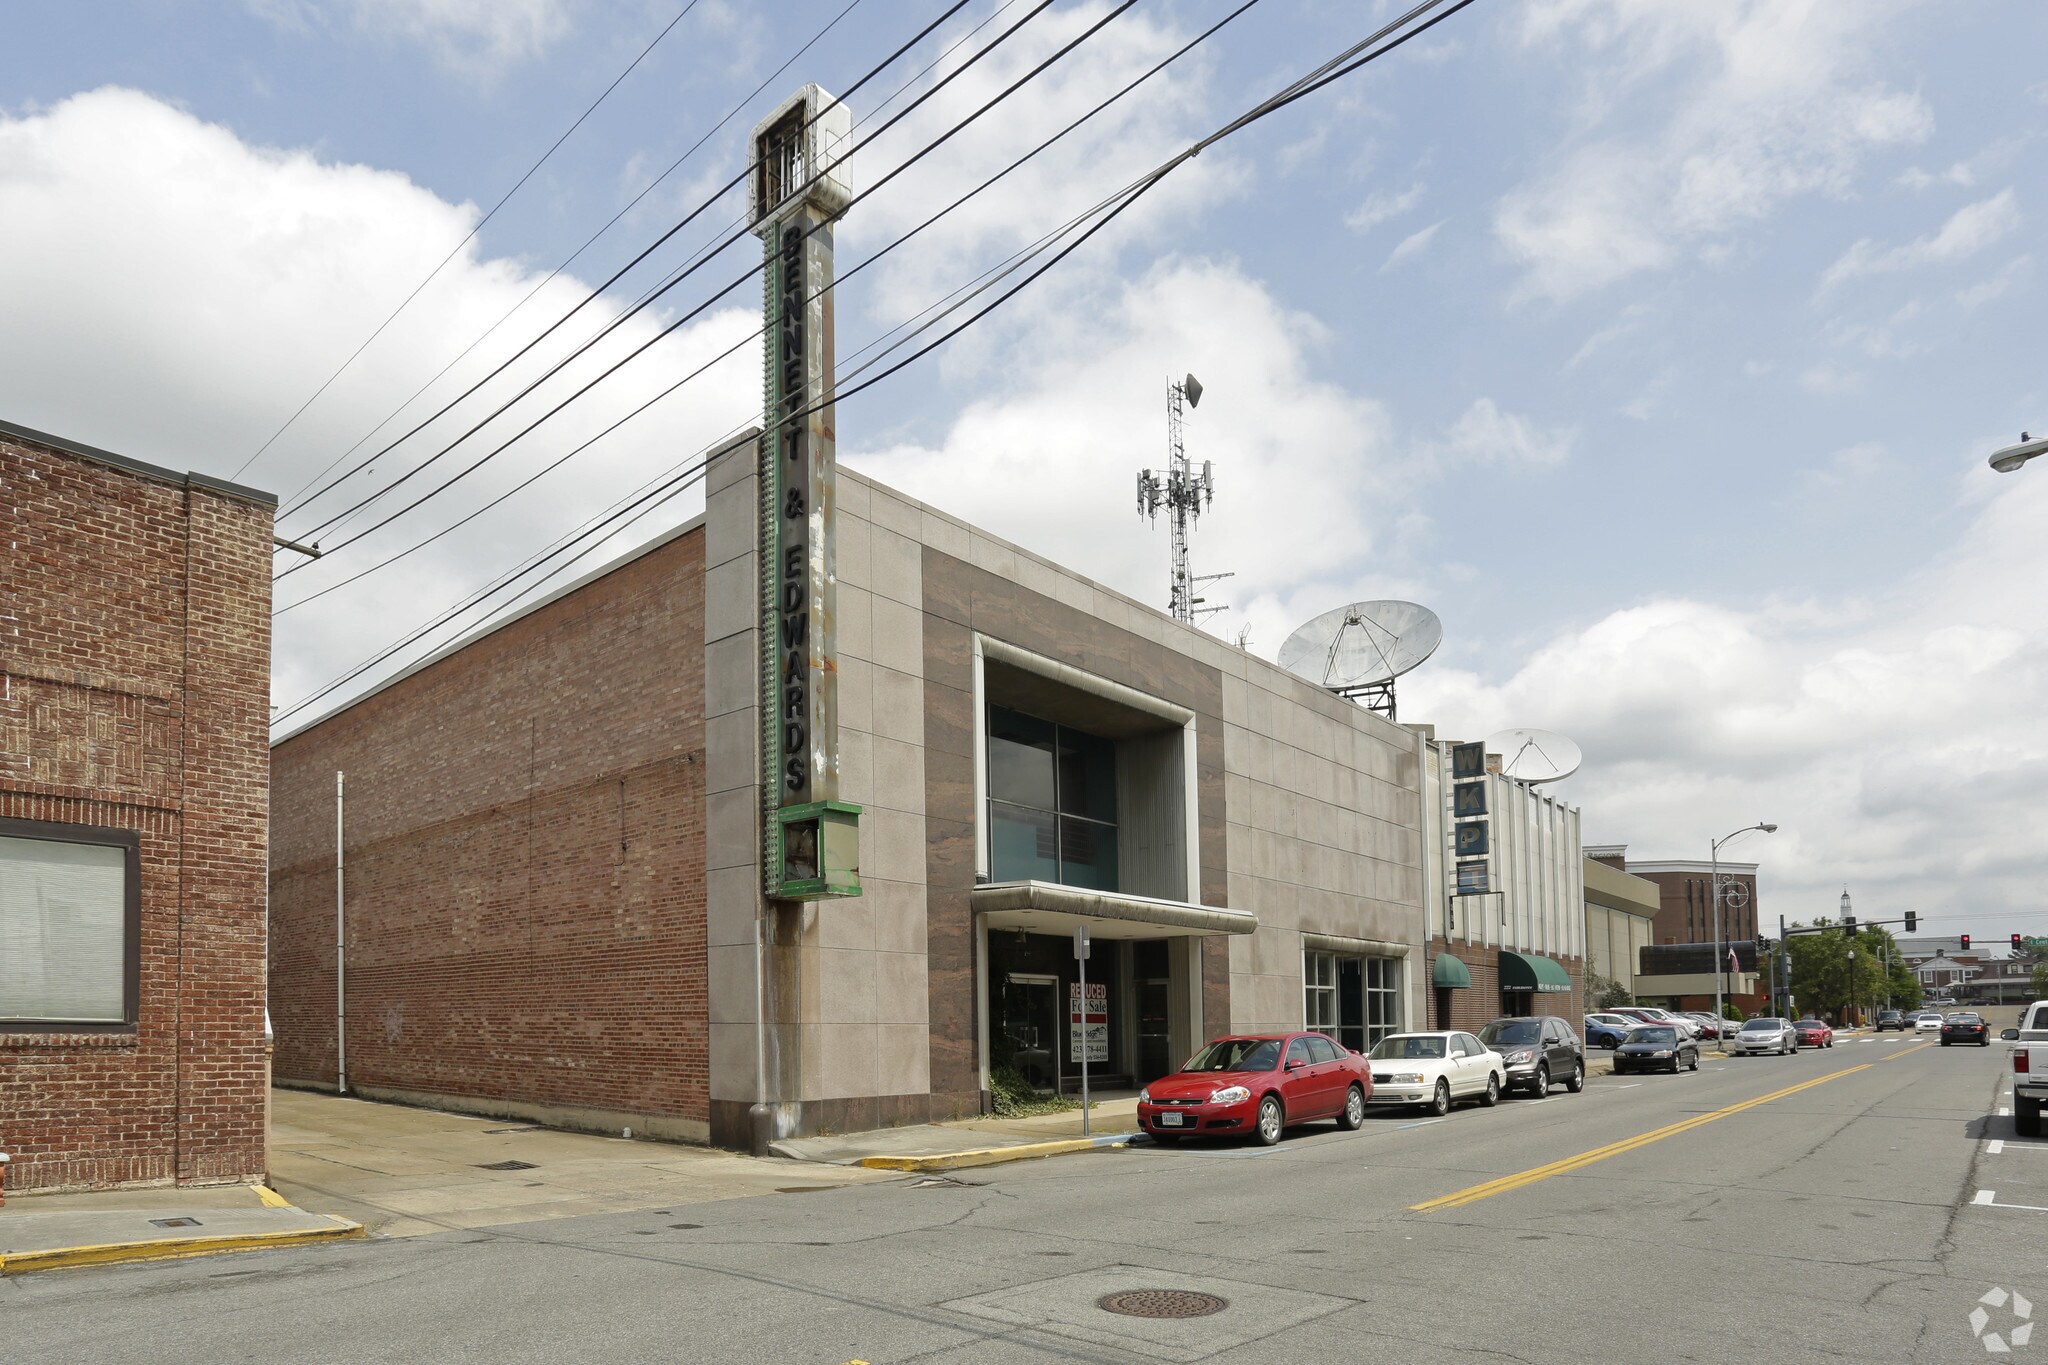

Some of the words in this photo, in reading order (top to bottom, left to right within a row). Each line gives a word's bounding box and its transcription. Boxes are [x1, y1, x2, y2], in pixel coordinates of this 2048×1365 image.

[782, 227, 803, 460] BENNETT
[784, 487, 804, 520] &
[782, 545, 806, 792] EDWARDS
[1456, 748, 1485, 890] WKPT
[1070, 982, 1107, 999] REUCED
[1089, 1000, 1106, 1013] Sale
